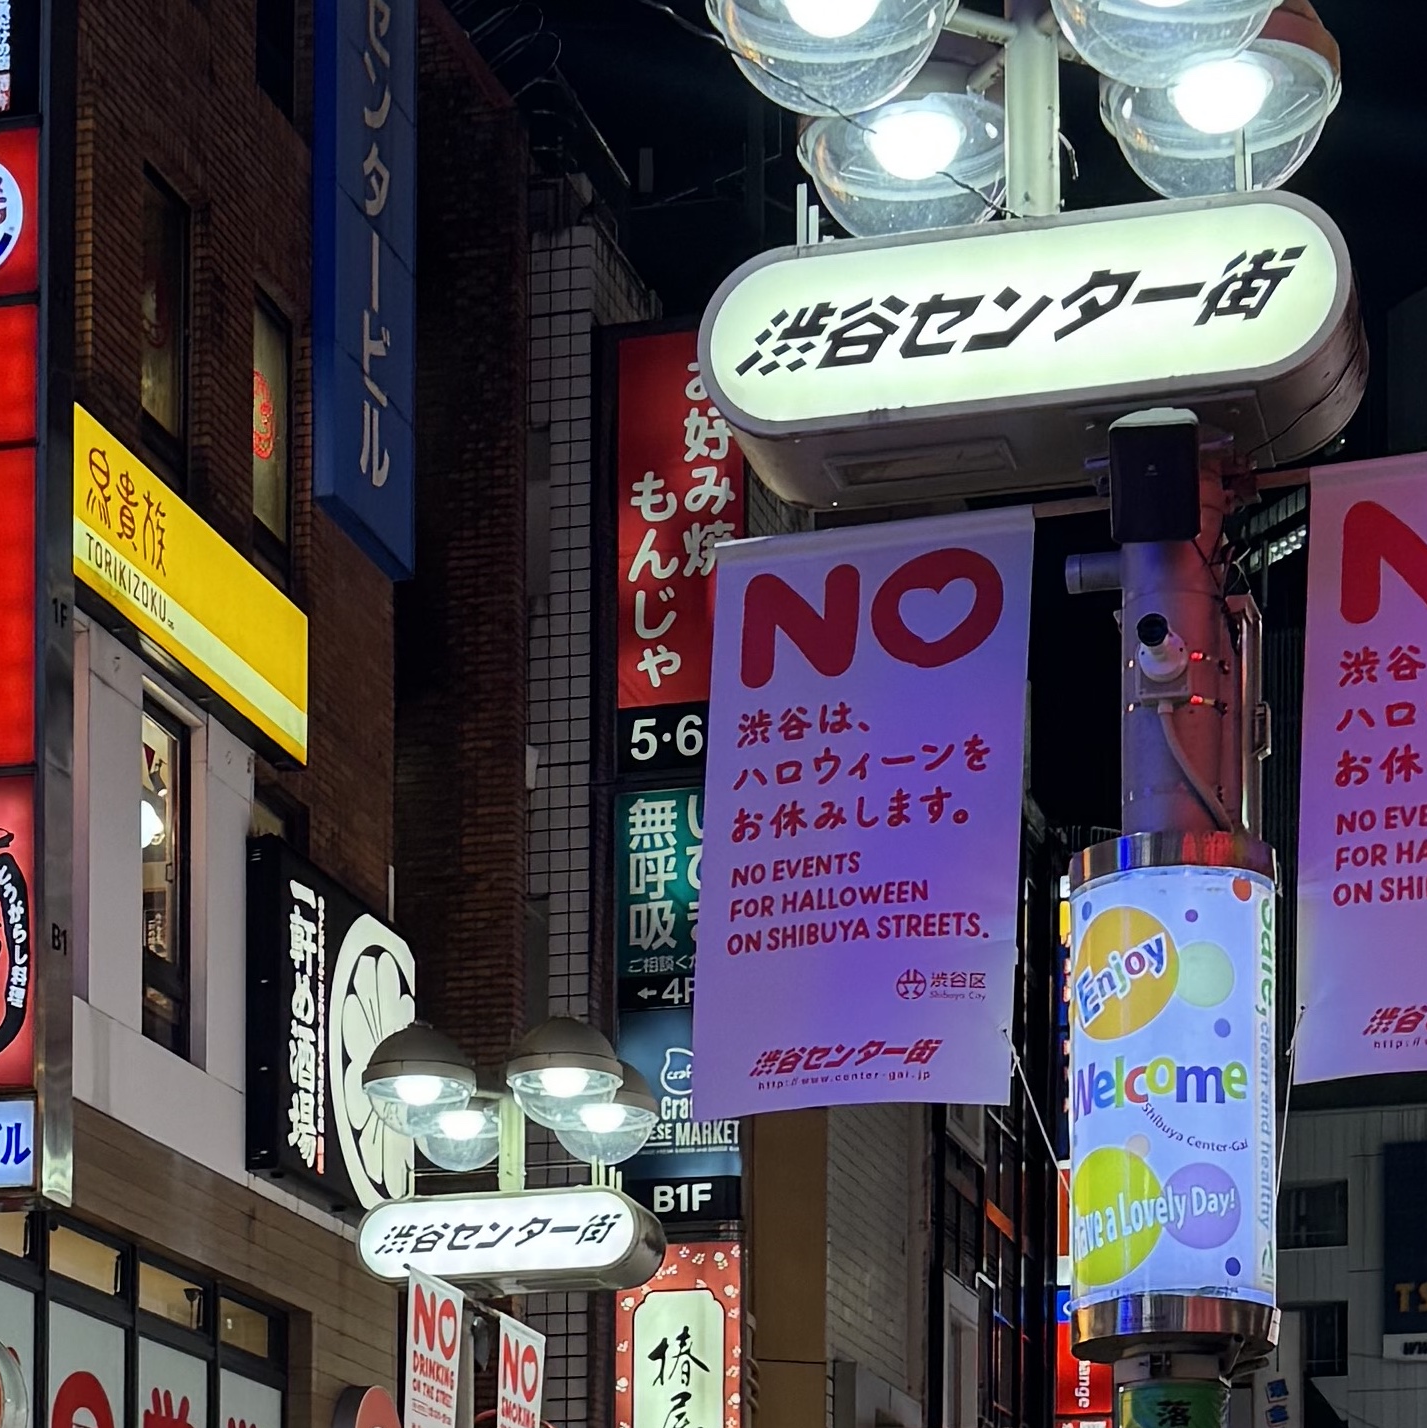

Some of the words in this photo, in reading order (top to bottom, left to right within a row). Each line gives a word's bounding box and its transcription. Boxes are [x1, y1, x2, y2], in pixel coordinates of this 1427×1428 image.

[735, 245, 1308, 378] 渋谷センター街
[85, 447, 167, 578] 鳥貴族
[84, 532, 167, 623] TORIKIZOKU
[629, 471, 680, 688] もんじゃ
[741, 548, 1003, 690] NO
[737, 702, 870, 749] 渋谷は、
[732, 734, 991, 791] ハロウィーンを
[731, 786, 969, 845] お休みします。
[1336, 810, 1376, 836] NO
[628, 798, 678, 952] 無呼吸
[731, 865, 766, 889] NO
[773, 851, 861, 883] EVENTS
[1336, 844, 1386, 872] FOR
[730, 896, 773, 922] FOR
[781, 880, 929, 914] HALLOWEEN
[1333, 881, 1373, 907] ON
[727, 932, 762, 955] ON
[767, 921, 870, 951] SHIBUYA
[876, 911, 990, 941] STREETS.
[930, 971, 986, 991] 渋谷区
[1076, 931, 1165, 1027] Enjoy
[288, 880, 317, 1168] 一軒め酒場
[750, 1038, 943, 1077] 渋谷センター街
[1074, 1055, 1247, 1123] Welcome
[676, 1120, 739, 1146] MARKET
[653, 1184, 711, 1213] B1F
[1106, 1209, 1118, 1230] a
[1120, 1189, 1187, 1237] Lovely
[1190, 1186, 1236, 1216] Day!
[375, 1214, 622, 1255] 渋谷センター街
[414, 1283, 457, 1360] NO
[503, 1333, 538, 1402] NO
